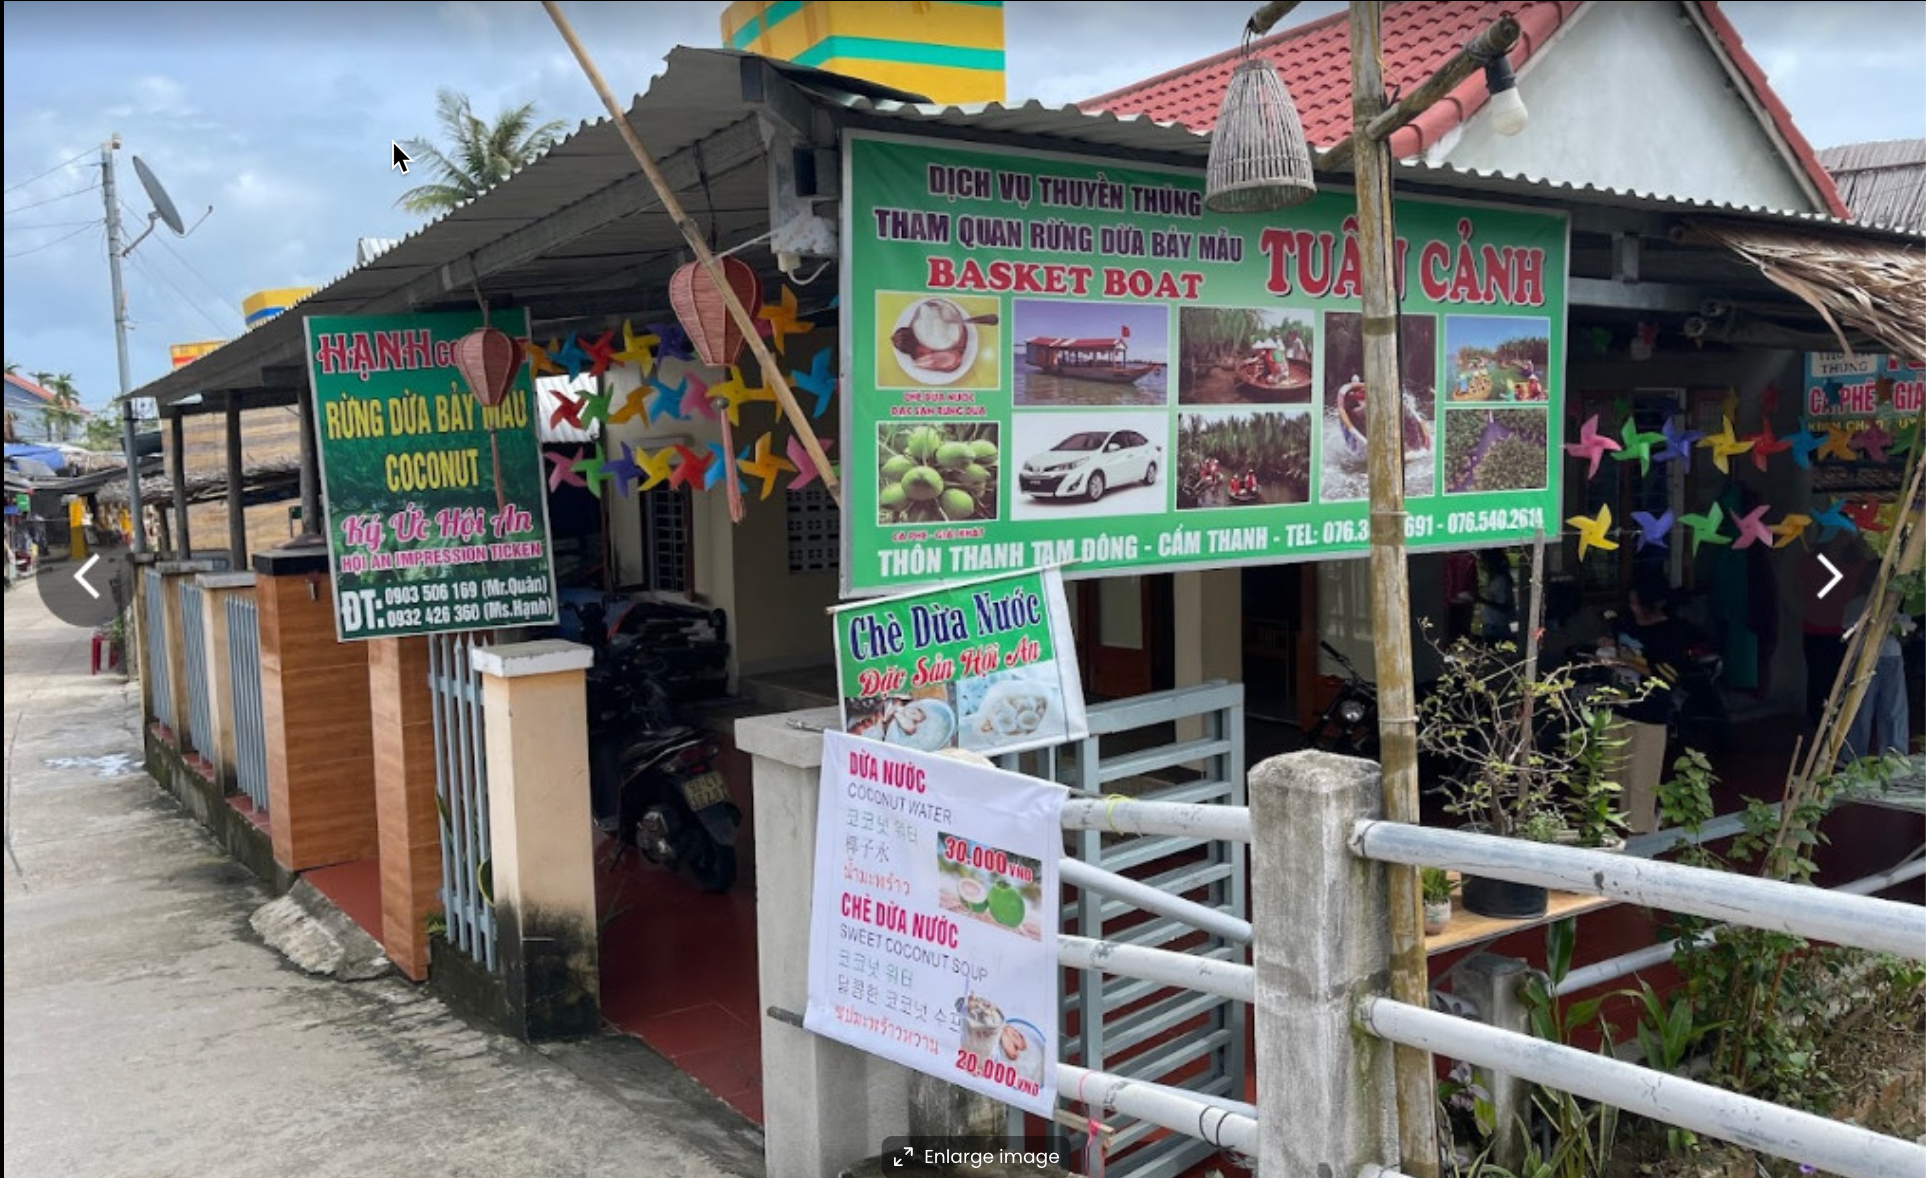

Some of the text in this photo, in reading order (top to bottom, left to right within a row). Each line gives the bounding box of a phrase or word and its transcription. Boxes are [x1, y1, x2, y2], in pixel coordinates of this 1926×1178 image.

[928, 164, 992, 201] DỊCH
[998, 172, 1032, 209] VỤ
[1038, 172, 1125, 212] THUYỀN
[873, 207, 950, 244] THAM
[958, 216, 1022, 249] QUAN
[1030, 218, 1092, 253] RỪNG
[1101, 221, 1146, 258] DỪA
[926, 256, 1204, 300] BASKET BOAT
[1419, 218, 1545, 307] CẢNH
[316, 329, 433, 381] HẠNH
[325, 392, 384, 439] RỪNG
[388, 388, 432, 436] DỪA
[435, 381, 475, 433] BẢY
[385, 449, 479, 492] COCONUT
[341, 514, 385, 554] Ký
[435, 506, 487, 542] Hội
[490, 503, 534, 539] An
[878, 543, 942, 577] THÔN
[949, 542, 1025, 573] THANH
[1207, 526, 1269, 553] THANH
[1285, 524, 1319, 548] TEL:
[394, 545, 488, 568] IMPRESSION
[489, 541, 543, 560] TICKEN
[341, 589, 385, 632] ĐT:
[384, 586, 420, 606] 0903
[422, 583, 449, 601] 506
[452, 581, 477, 600] 169
[386, 607, 422, 627] 0932
[425, 605, 451, 624] 426
[454, 602, 480, 621] 360
[850, 587, 1041, 661] Chè Dừa Nước
[858, 637, 1040, 698] Đặc Sản Hội An
[849, 748, 926, 794] DỪA NƯỚC
[848, 782, 952, 824] COCONUT WATER
[841, 892, 959, 949] CHÈ DỪA NƯỚC
[840, 923, 988, 982] SWEET COCONUT SOUP
